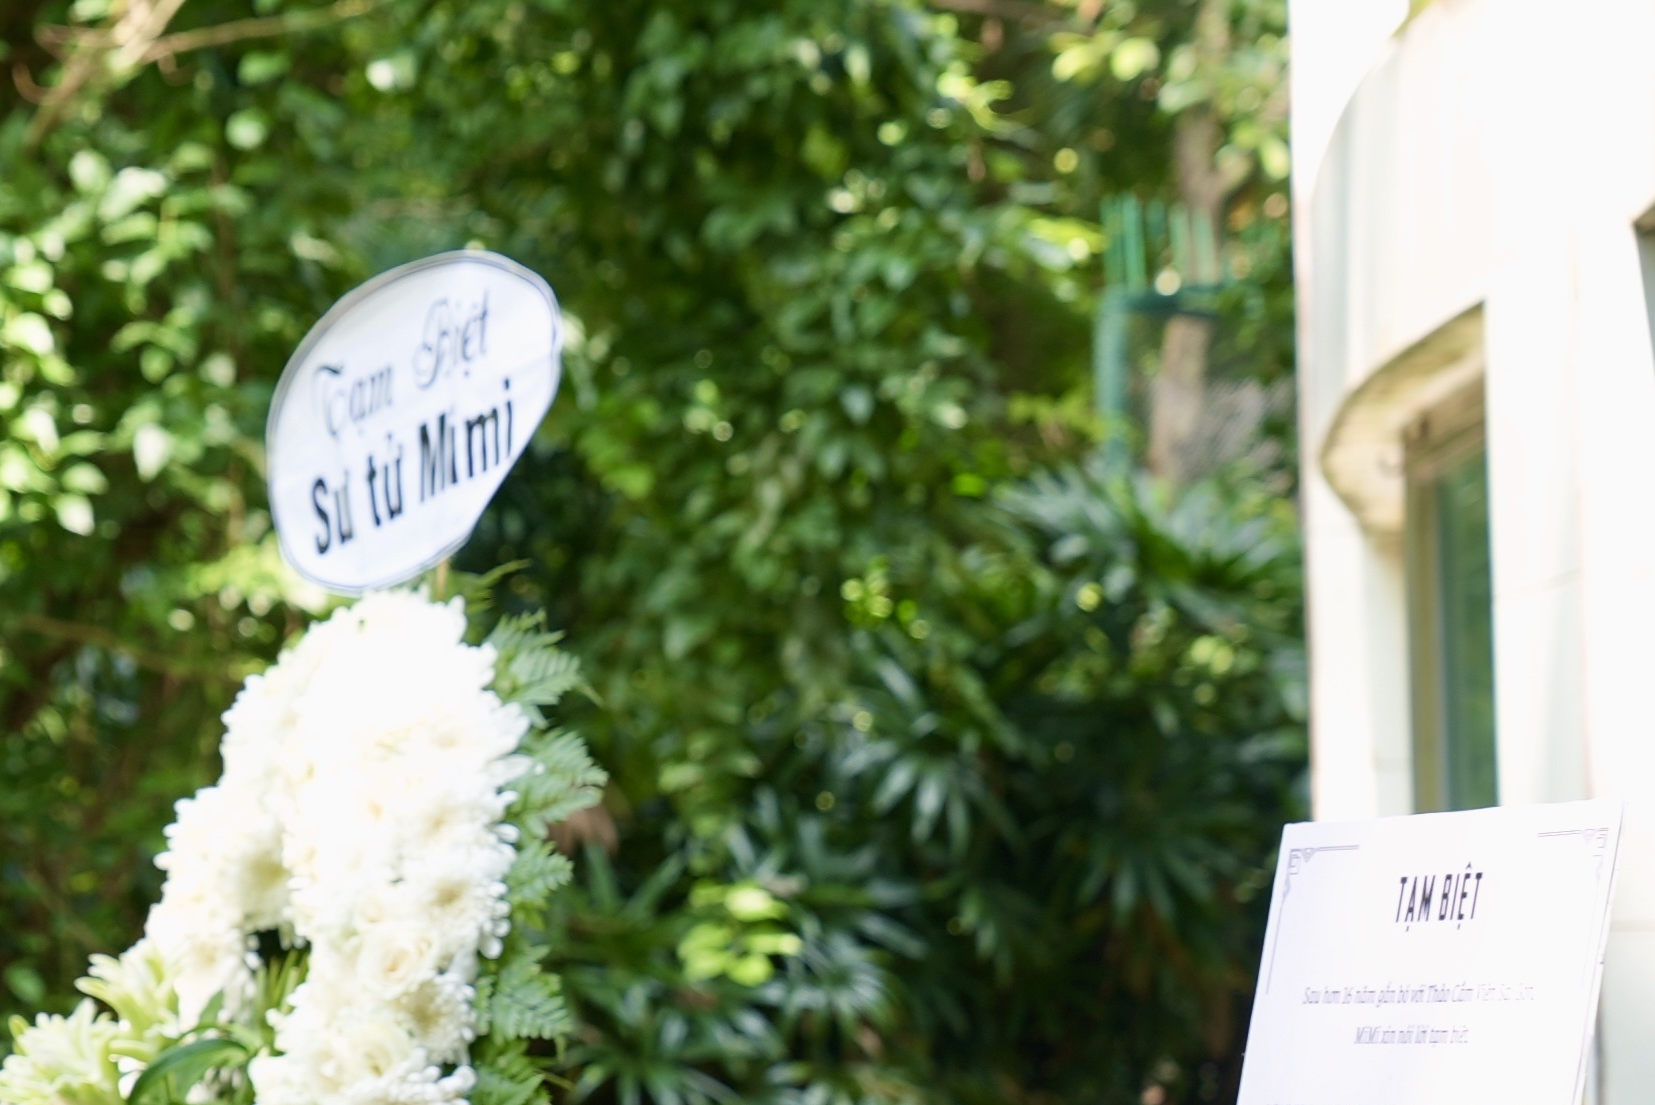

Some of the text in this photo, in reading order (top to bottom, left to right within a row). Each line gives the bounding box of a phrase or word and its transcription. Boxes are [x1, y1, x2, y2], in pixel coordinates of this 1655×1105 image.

[419, 377, 512, 502] Mimi
[1395, 861, 1483, 933] TẠM BIỆT
